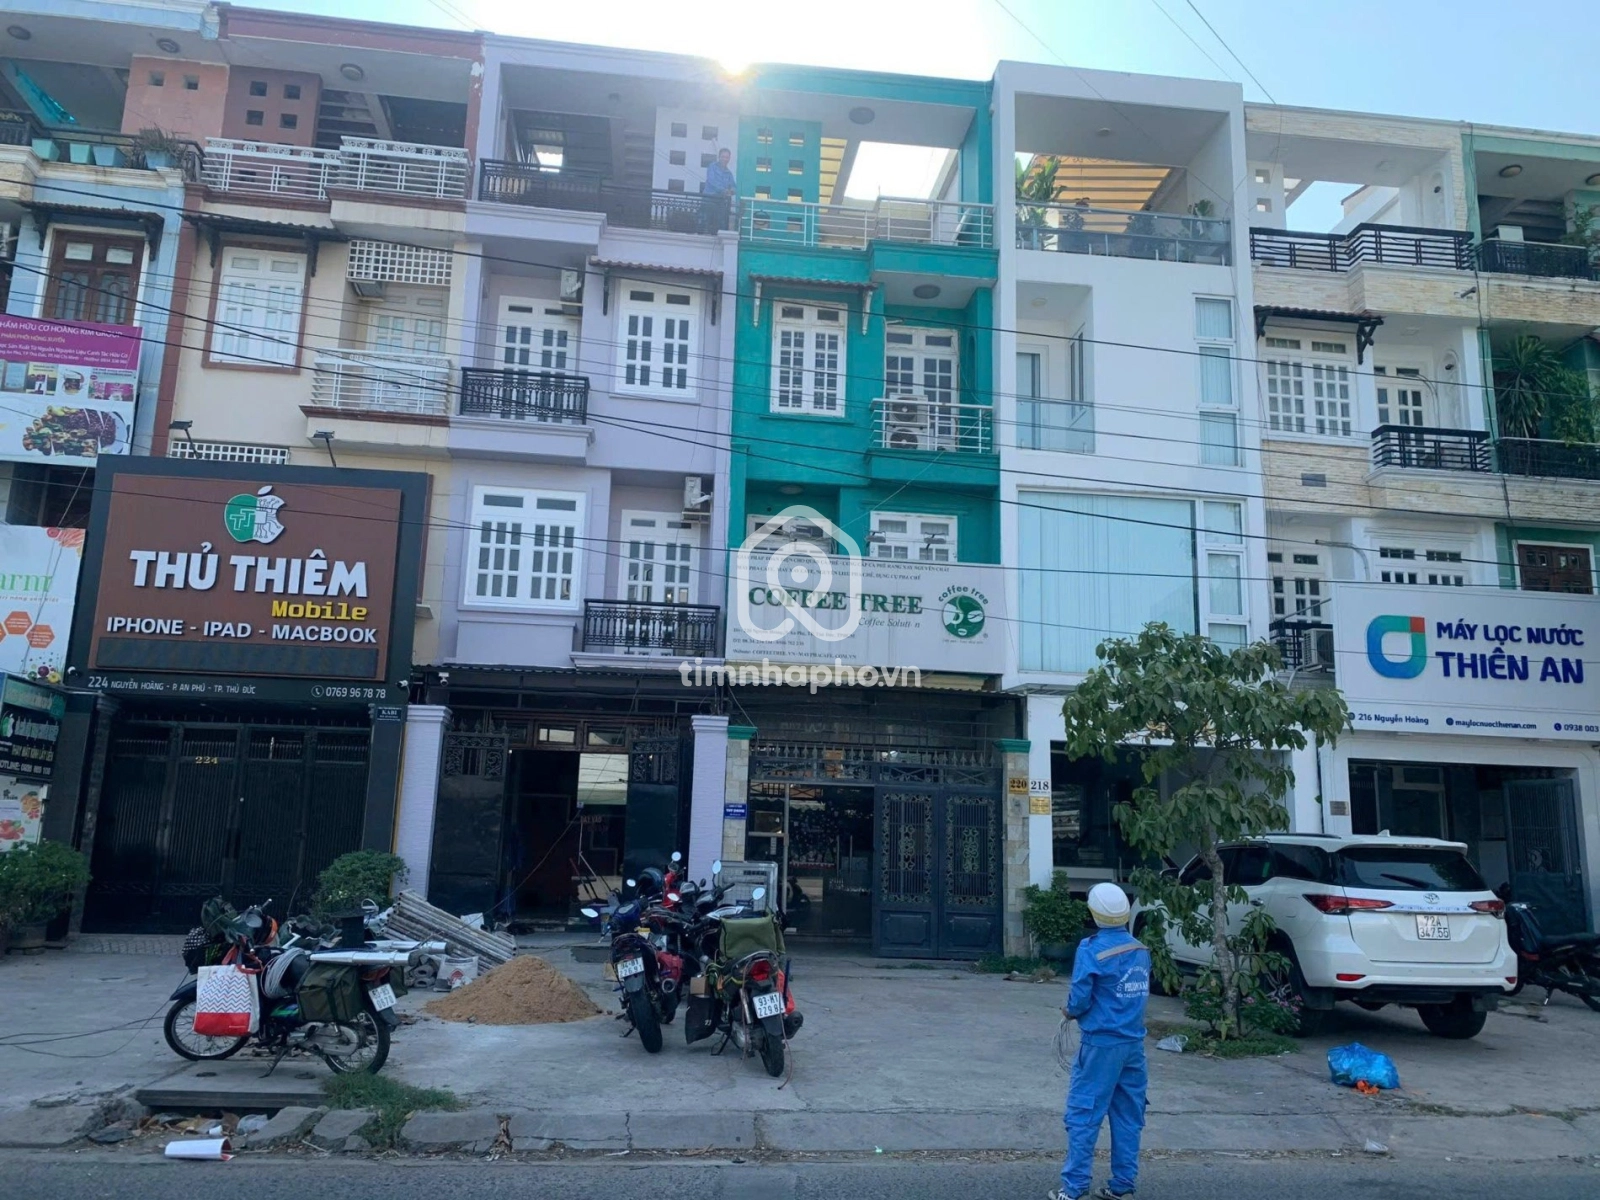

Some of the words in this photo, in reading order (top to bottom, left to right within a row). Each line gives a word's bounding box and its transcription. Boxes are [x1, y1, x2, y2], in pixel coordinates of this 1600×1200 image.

[80, 328, 94, 336] KIM
[130, 542, 219, 591] THỦ
[229, 548, 369, 598] THIÊM
[748, 586, 848, 611] COFFEE
[855, 592, 924, 615] TREE
[938, 585, 968, 603] coffee
[971, 587, 989, 605] tree
[272, 600, 368, 622] Mobile
[106, 616, 185, 636] IPHONE
[203, 620, 253, 639] IPAD
[272, 624, 378, 644] MACBOOK
[858, 617, 886, 629] Coffee
[1436, 618, 1478, 641] MÁY
[1483, 624, 1522, 646] LỌC
[1527, 623, 1585, 646] NƯỚC
[1435, 646, 1529, 681] THIÊN
[1539, 656, 1584, 684] AN
[87, 676, 109, 689] 224
[111, 677, 138, 690] NGUYỄN
[179, 684, 190, 692] AN
[242, 684, 256, 695] ĐỨC
[325, 686, 348, 698] 0769
[349, 687, 361, 698] 96
[363, 688, 374, 699] 78
[375, 688, 387, 699] 78
[1358, 712, 1372, 722] 216
[1374, 713, 1403, 725] Nguyễn
[1405, 714, 1429, 726] Hoàng
[1564, 723, 1584, 732] 0938
[1584, 723, 1600, 733] 003
[1010, 779, 1027, 789] 220
[1030, 780, 1050, 791] 218
[1424, 915, 1442, 927] 72A
